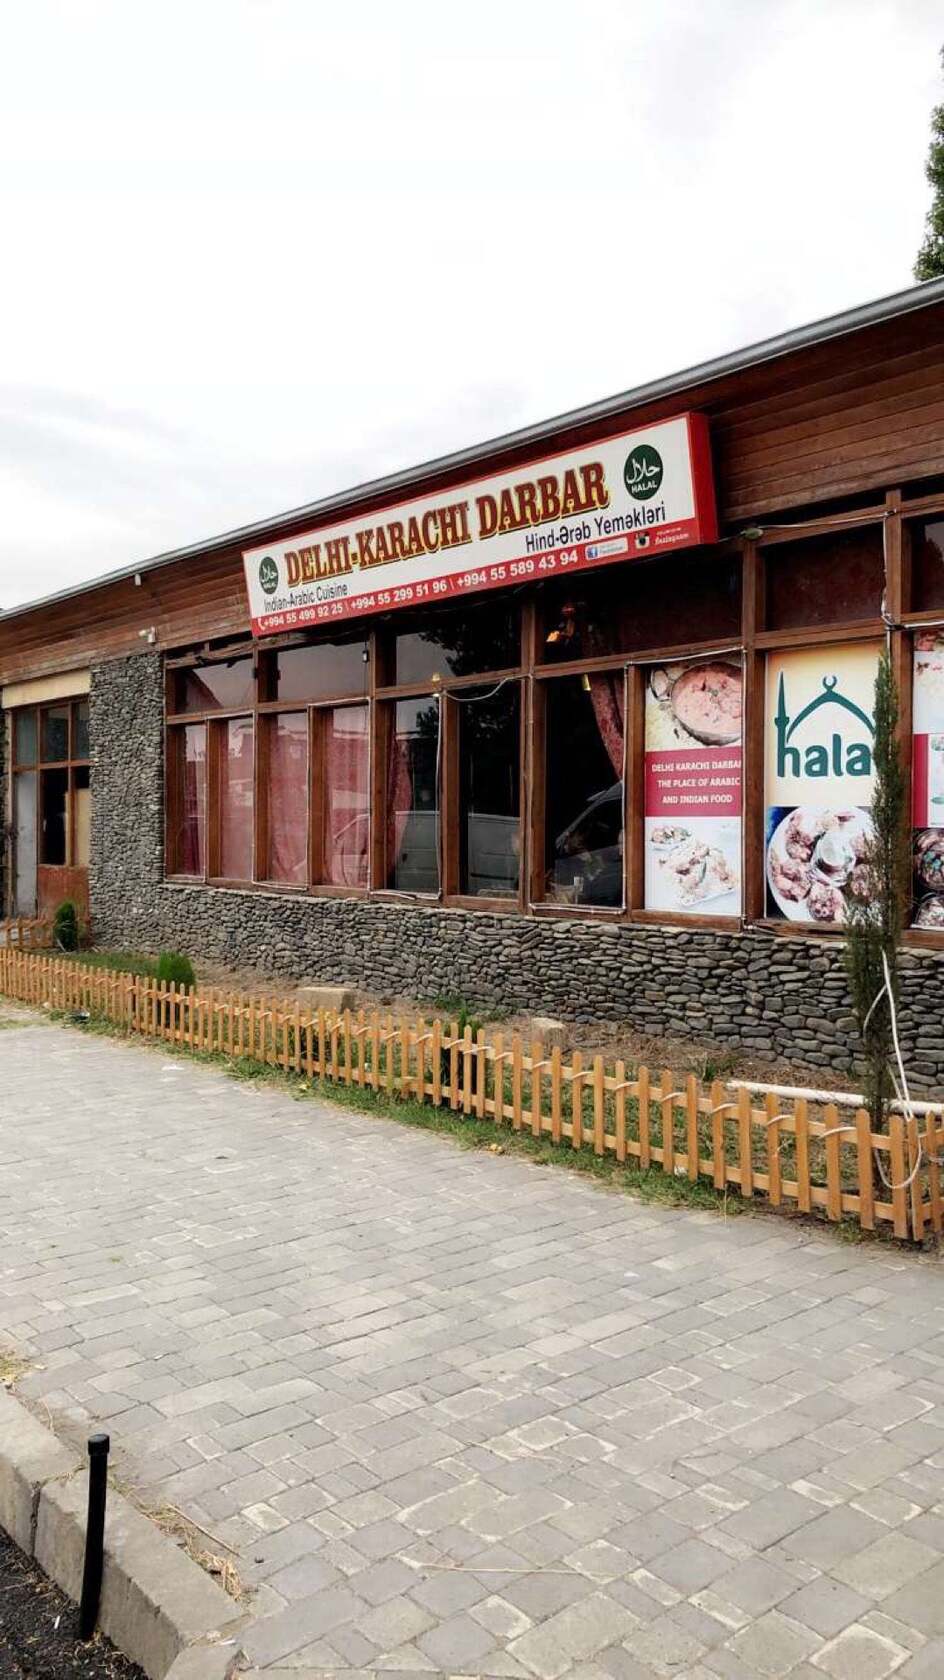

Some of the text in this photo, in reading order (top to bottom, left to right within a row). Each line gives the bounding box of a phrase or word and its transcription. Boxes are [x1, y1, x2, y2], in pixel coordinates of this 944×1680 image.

[631, 480, 657, 494] HALAL
[284, 461, 611, 588] DELHI-KARACHI DARBAR
[594, 500, 666, 538] Yeməkləri
[263, 549, 578, 628] +994 55 499 92 25 +994 55 299 51 96 +994 55 589 43 94
[264, 583, 348, 613] Indian-Arabic Cuisine
[651, 763, 674, 772] DELHI
[675, 761, 710, 771] KARACHI
[777, 732, 874, 778] hala
[657, 777, 741, 788] THE PLACE OF ARABIC
[662, 794, 733, 804] AND INDIAN FOOD
